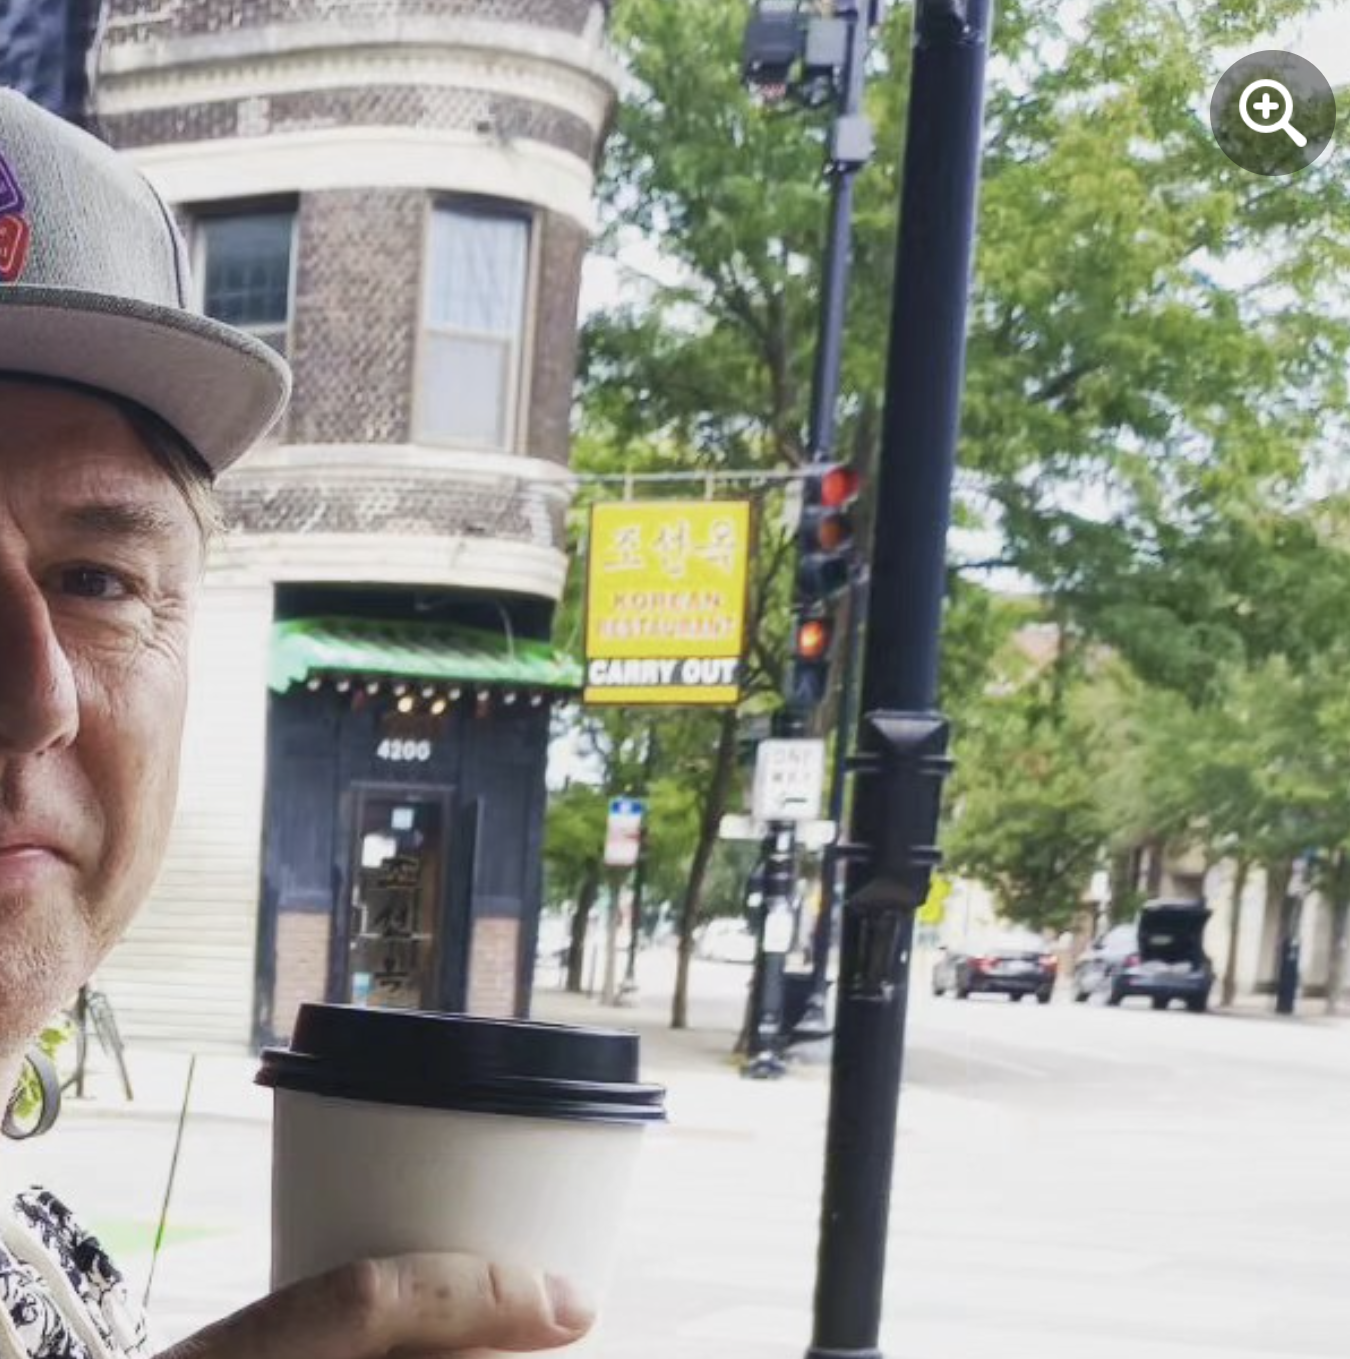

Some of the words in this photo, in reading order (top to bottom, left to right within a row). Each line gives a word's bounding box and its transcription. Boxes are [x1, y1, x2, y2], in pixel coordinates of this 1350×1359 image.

[604, 513, 735, 579] 조선옥
[588, 659, 677, 686] CARRY
[680, 658, 736, 685] OUT
[376, 738, 431, 762] 4200
